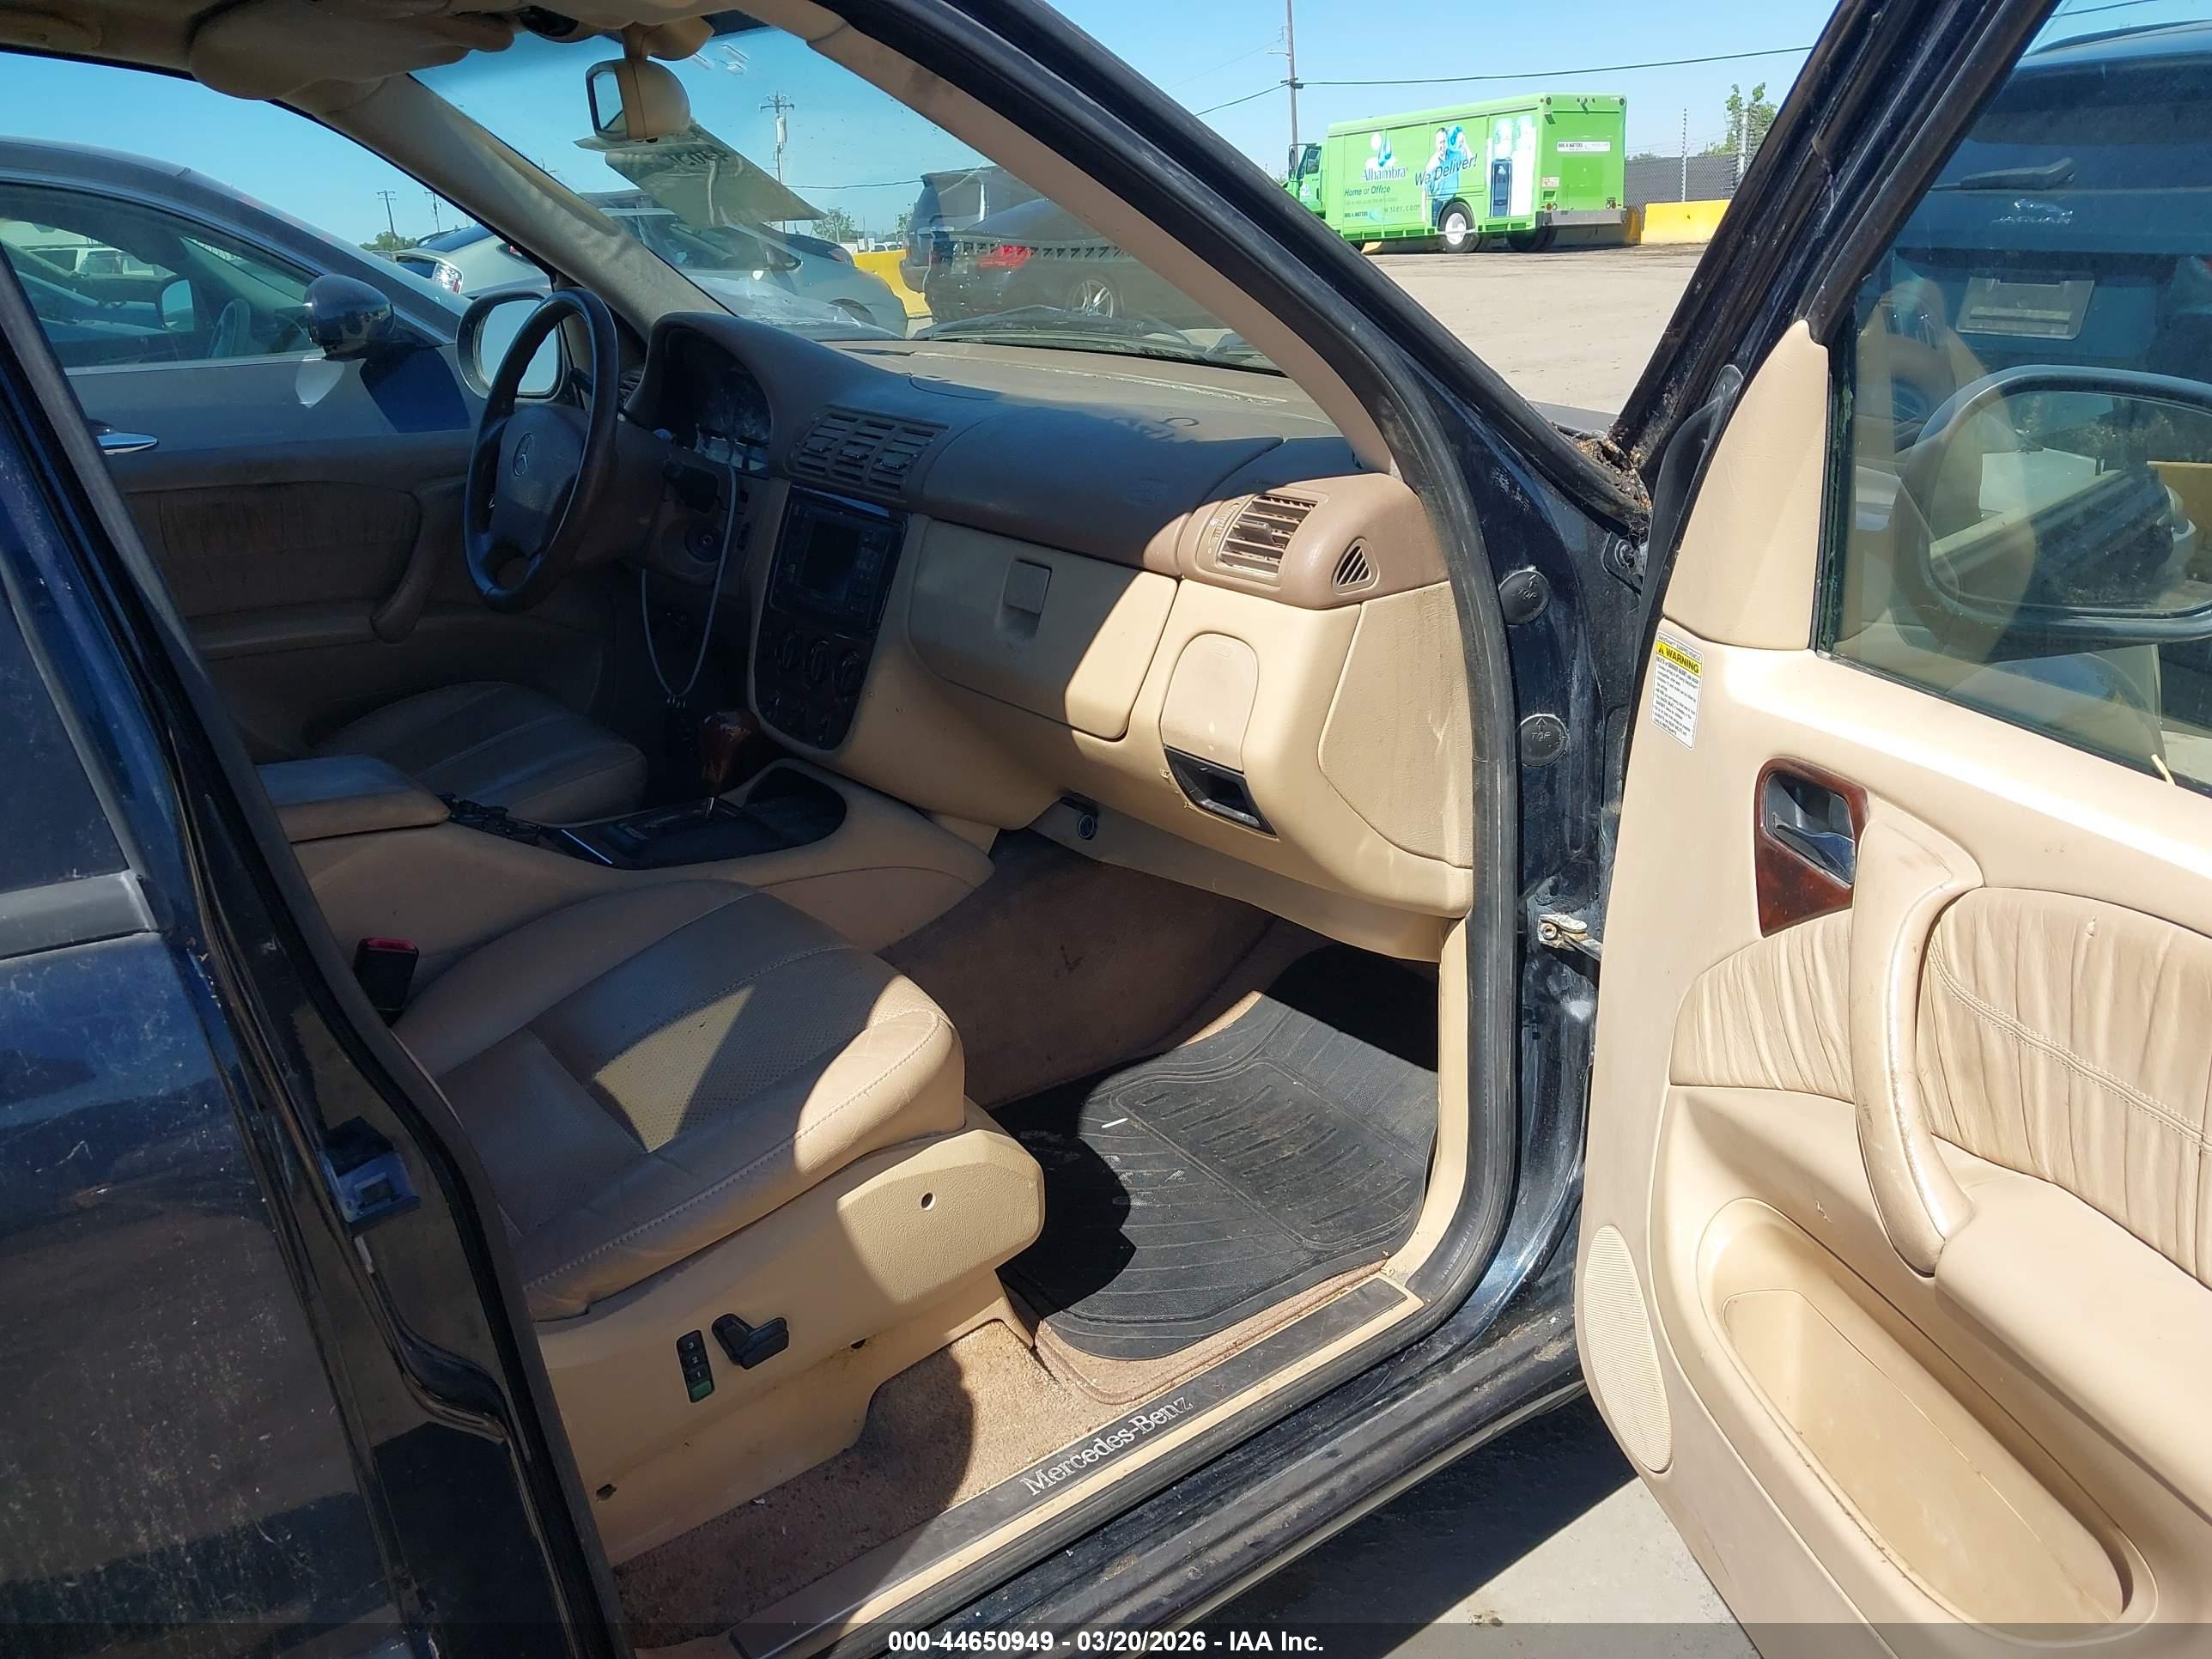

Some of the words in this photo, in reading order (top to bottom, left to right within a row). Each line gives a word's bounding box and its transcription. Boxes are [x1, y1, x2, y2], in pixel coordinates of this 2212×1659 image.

[1364, 167, 1407, 181] Alhambra
[1415, 171, 1431, 185] We
[1434, 154, 1477, 180] Deliver!
[1345, 187, 1362, 197] Home
[1370, 185, 1391, 194] Office
[1518, 587, 1538, 600] TOP
[1666, 647, 1699, 673] WARNING
[1531, 732, 1553, 743] TOP
[689, 1341, 694, 1350] 3
[1018, 1396, 1194, 1496] Mercedes-Benz
